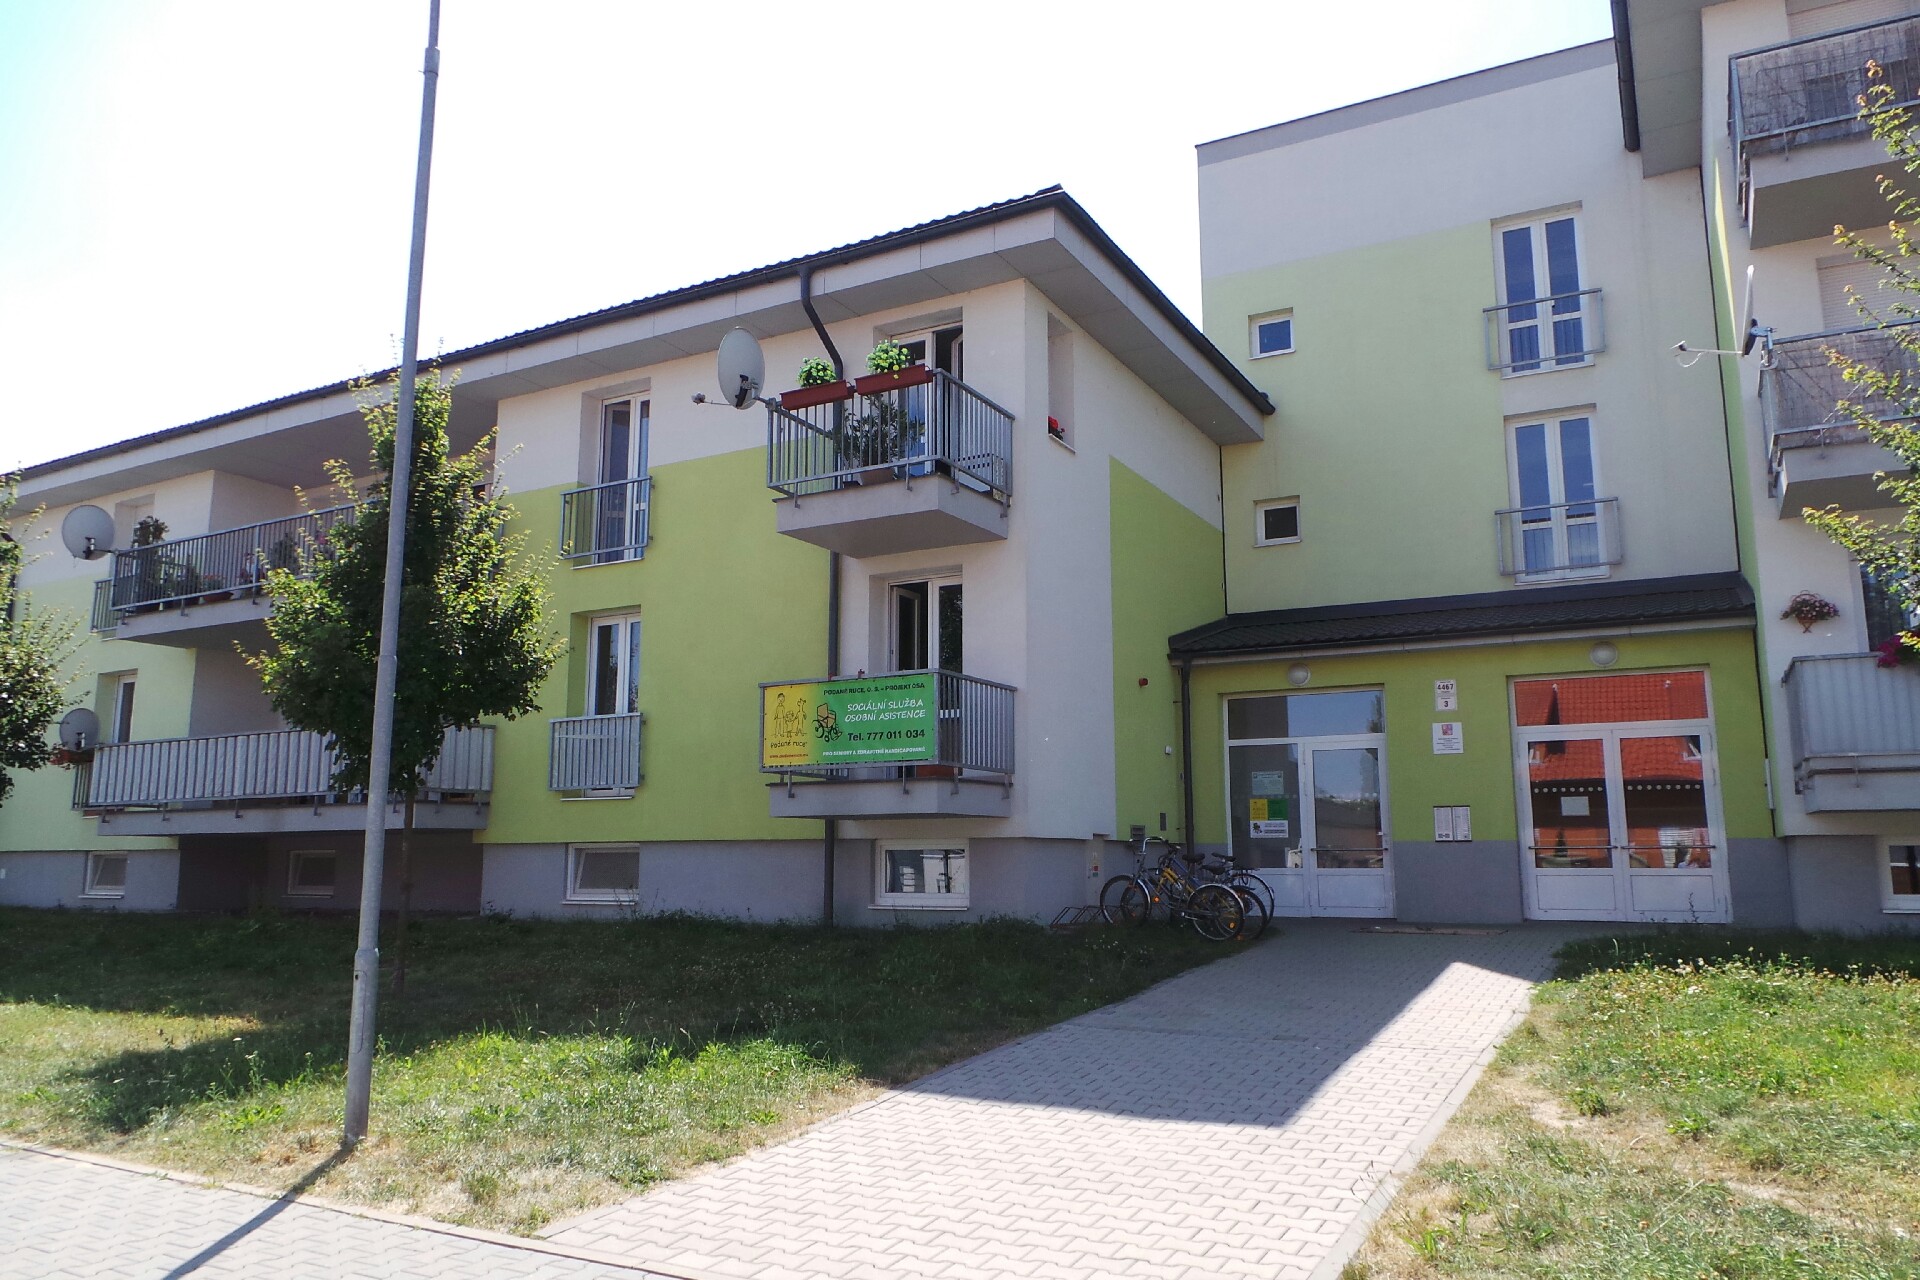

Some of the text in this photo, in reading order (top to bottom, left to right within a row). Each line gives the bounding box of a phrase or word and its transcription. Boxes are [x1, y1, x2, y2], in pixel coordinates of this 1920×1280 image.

[1437, 683, 1454, 691] 4467
[847, 698, 924, 712] SOCIÁLNÍ SLUŽBA
[1443, 700, 1449, 708] 3
[844, 709, 926, 722] OSOBNÍ ASISTENCE
[847, 729, 926, 741] Tel. 777 011 034
